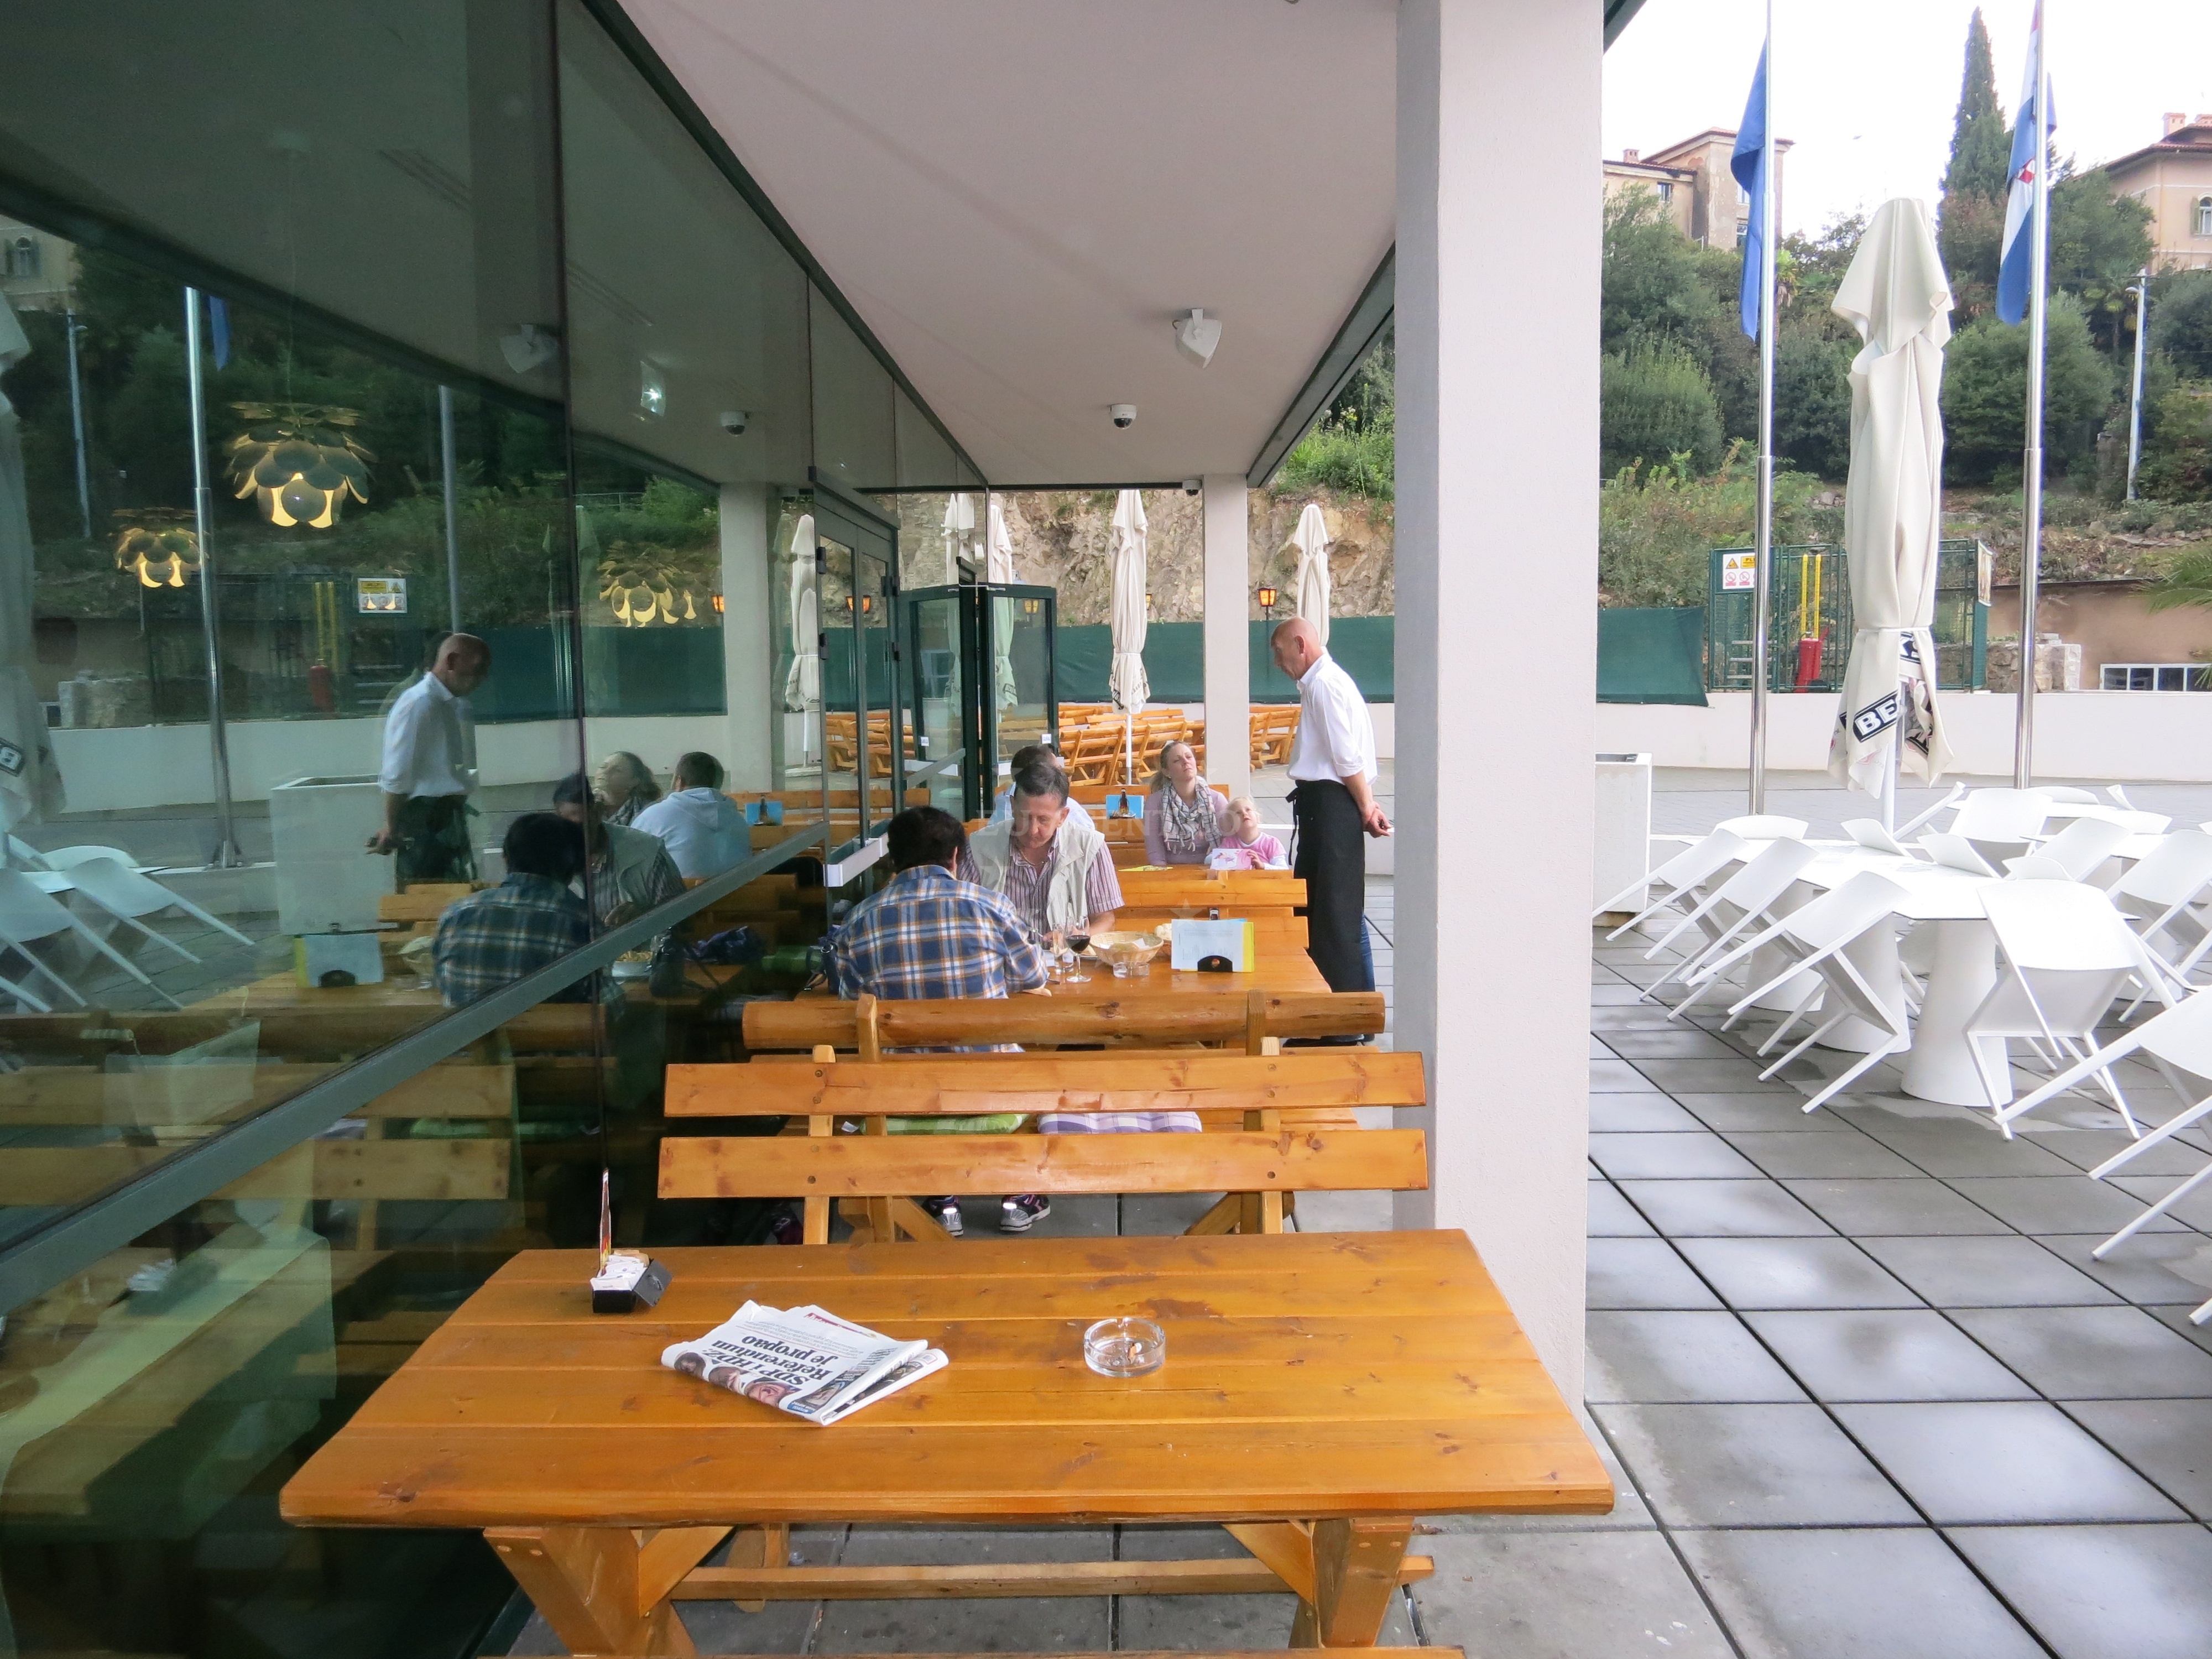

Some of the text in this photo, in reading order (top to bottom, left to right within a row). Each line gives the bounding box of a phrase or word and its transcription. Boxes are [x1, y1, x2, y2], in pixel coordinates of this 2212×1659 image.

[1854, 696, 1898, 736] BE
[741, 1335, 818, 1358] propao
[711, 1340, 833, 1381] Referendum
[810, 1355, 838, 1367] je
[759, 1369, 811, 1385] SDP
